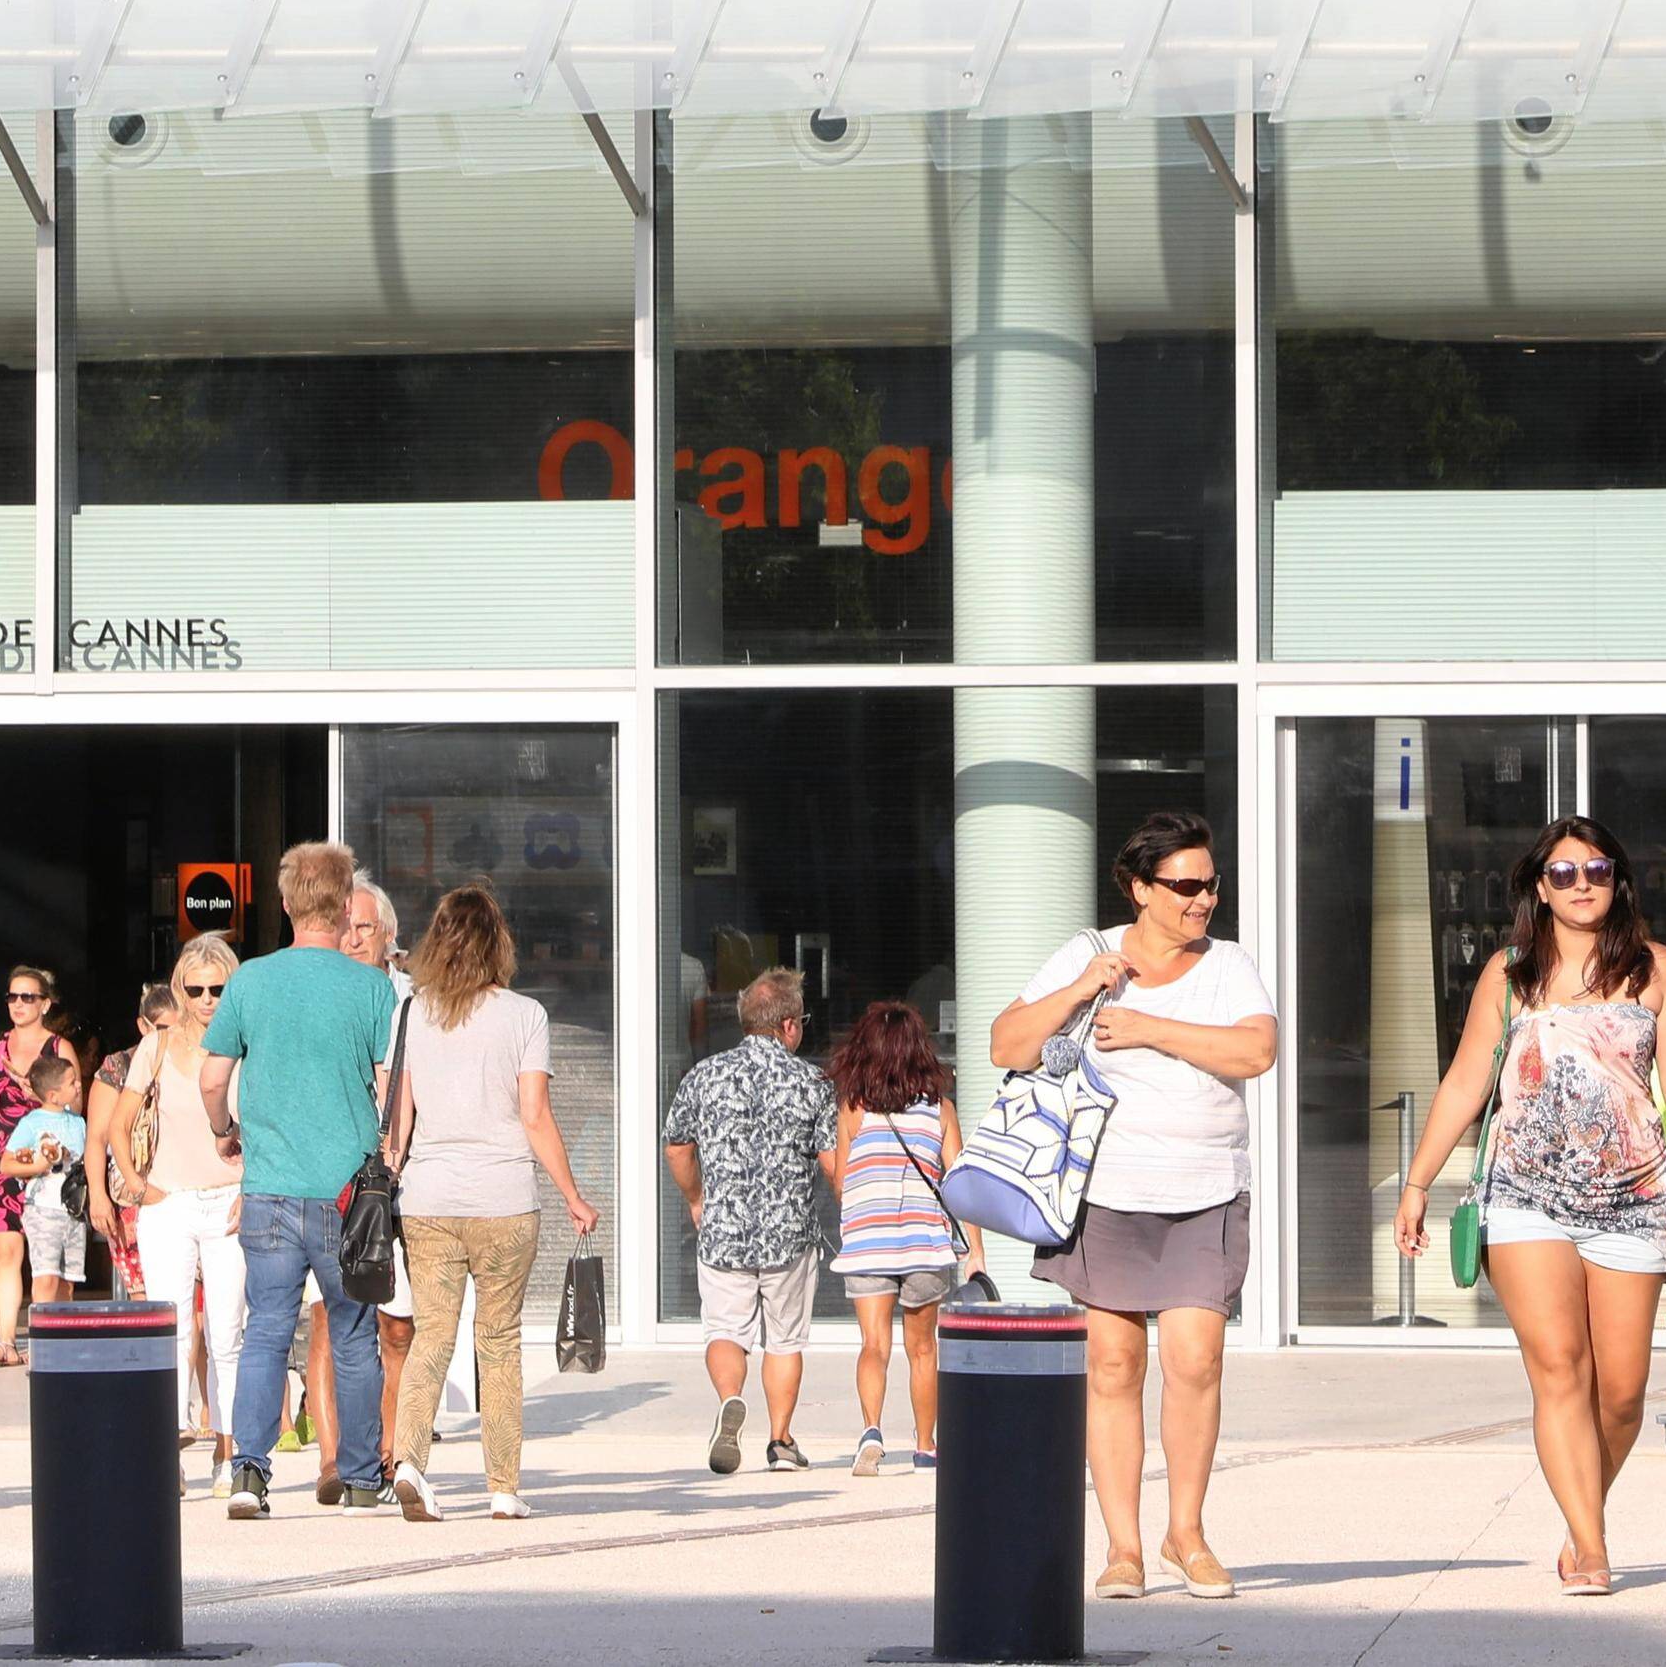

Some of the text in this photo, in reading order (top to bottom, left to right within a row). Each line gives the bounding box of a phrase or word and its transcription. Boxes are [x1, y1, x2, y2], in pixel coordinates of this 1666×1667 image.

[68, 619, 228, 648] CANNES
[186, 896, 232, 911] Bon plan
